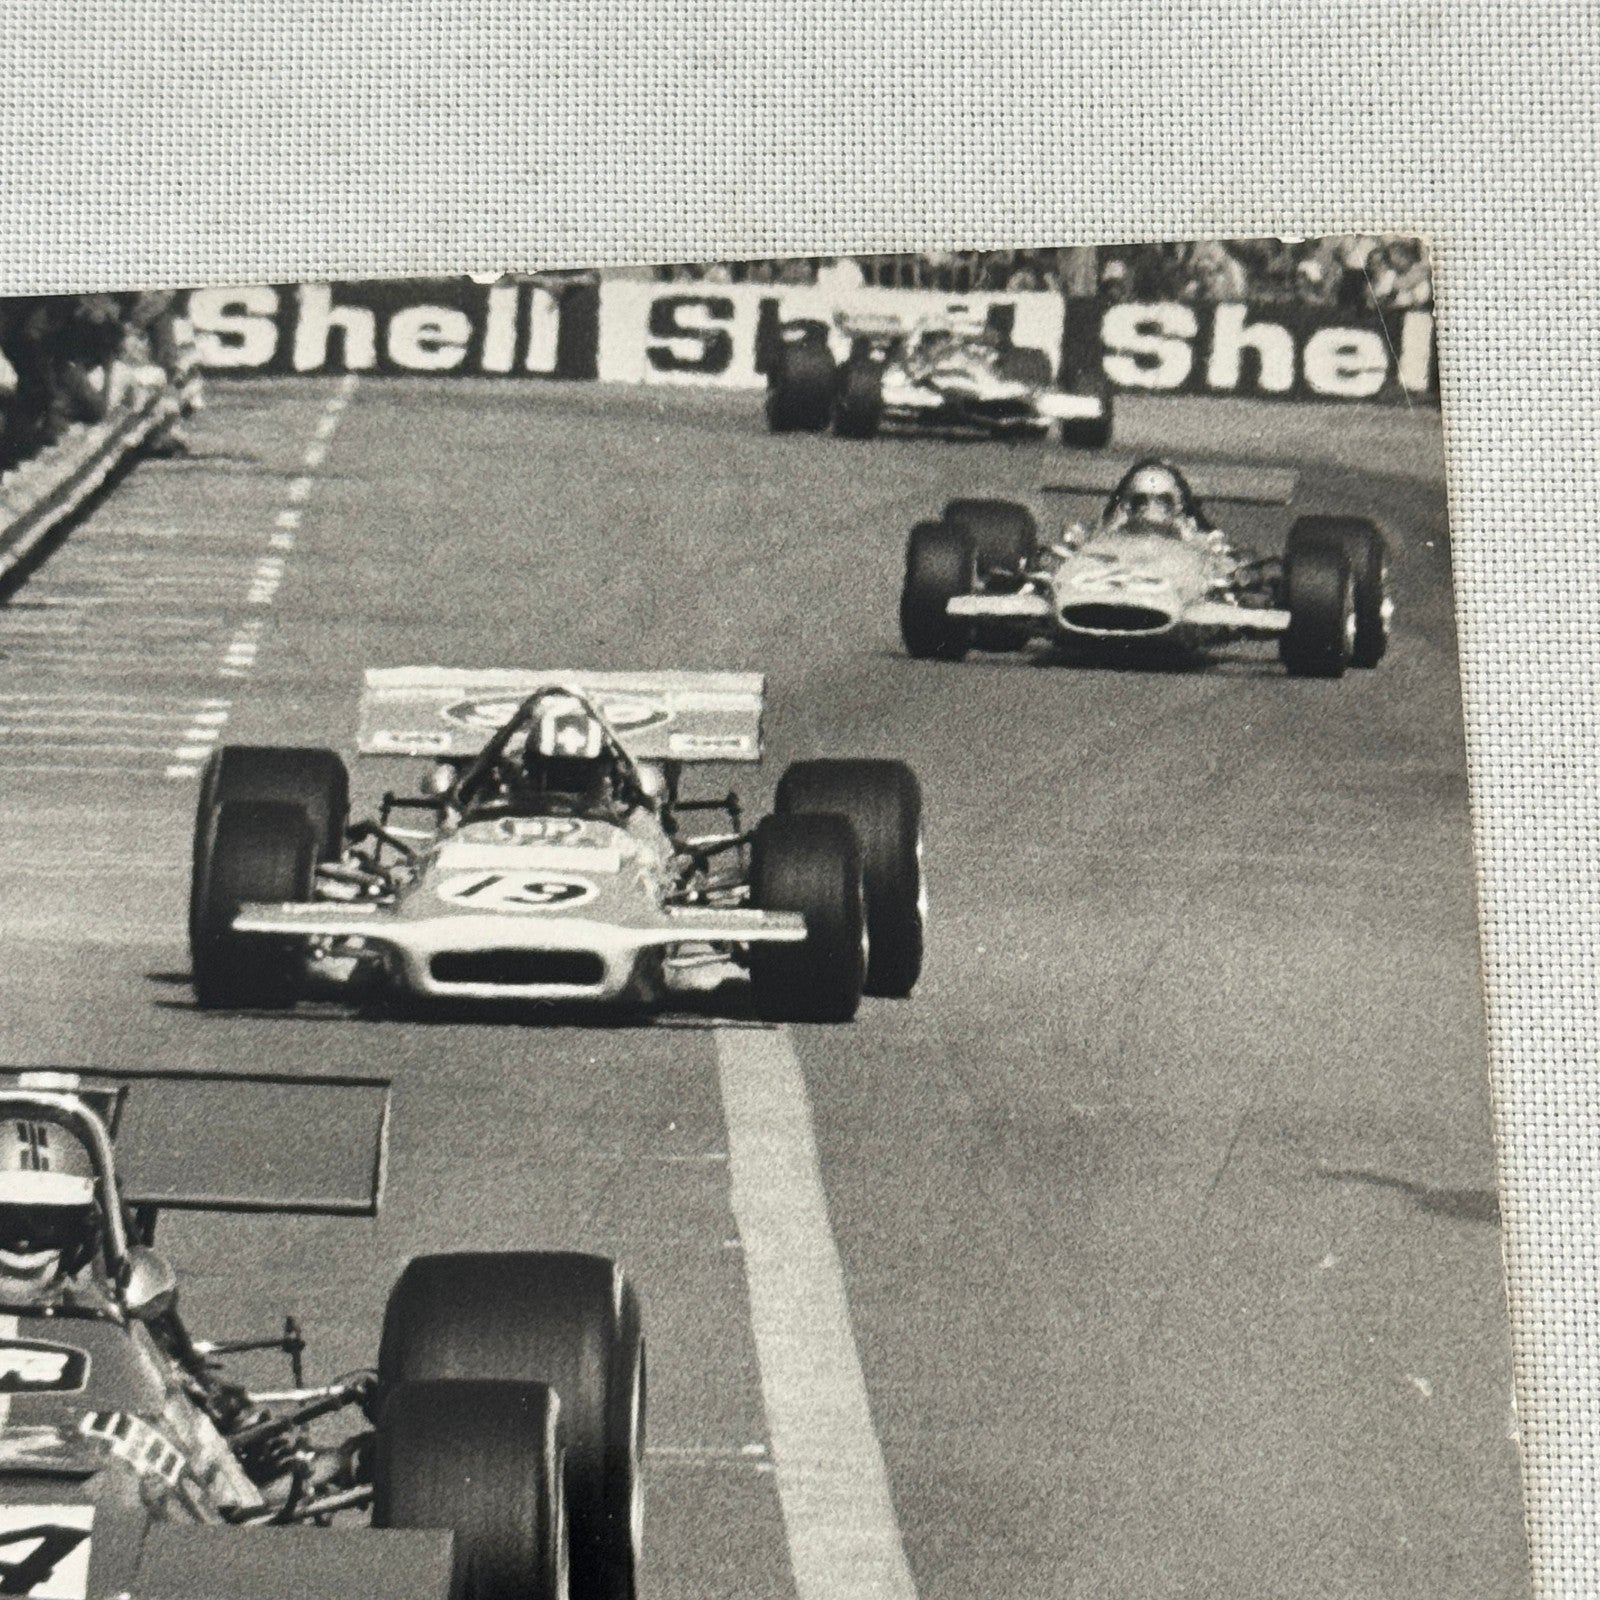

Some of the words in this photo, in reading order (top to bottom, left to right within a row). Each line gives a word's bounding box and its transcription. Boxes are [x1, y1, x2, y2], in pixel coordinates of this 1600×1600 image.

[188, 284, 559, 371] Shell
[1101, 301, 1433, 397] Shel
[454, 874, 587, 905] 19
